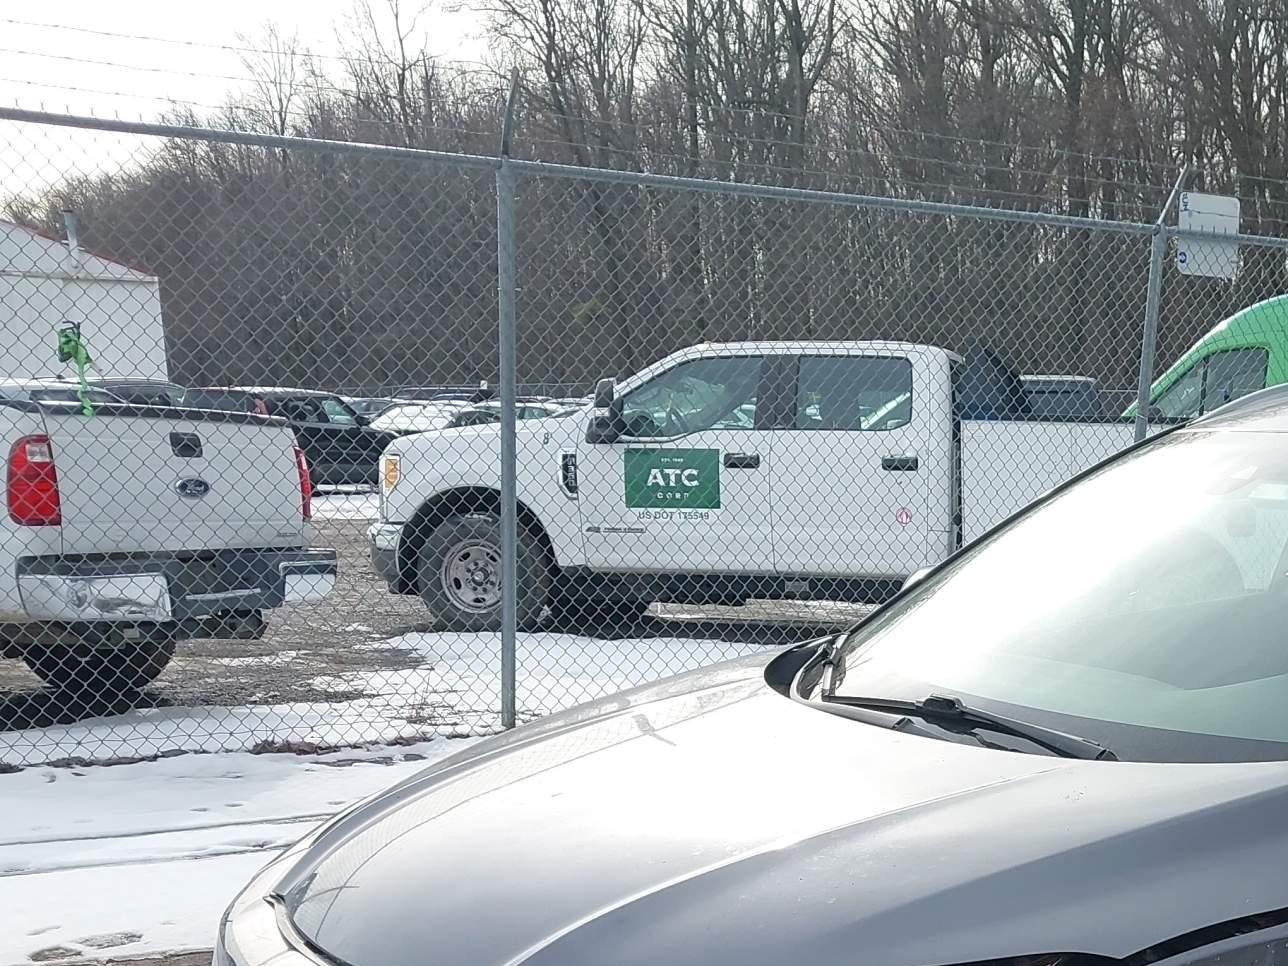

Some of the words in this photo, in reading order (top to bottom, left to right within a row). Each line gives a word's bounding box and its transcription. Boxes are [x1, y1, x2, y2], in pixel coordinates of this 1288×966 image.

[543, 432, 550, 445] 8
[646, 468, 700, 487] ATC
[656, 491, 689, 500] CORP
[638, 510, 652, 520] US
[654, 510, 675, 520] DOT
